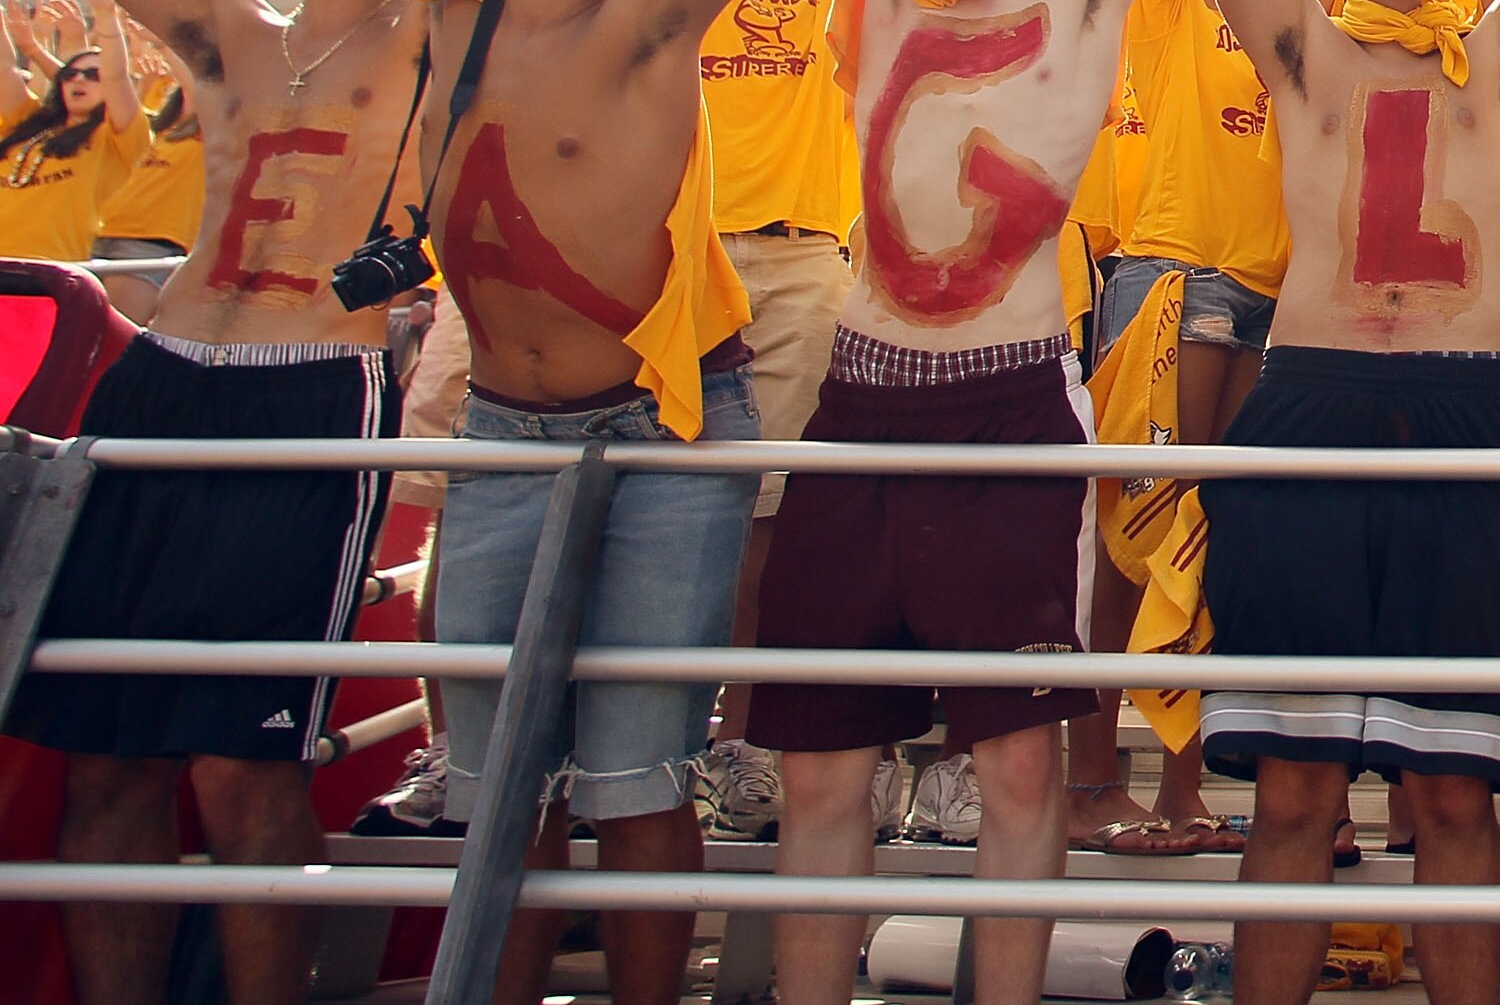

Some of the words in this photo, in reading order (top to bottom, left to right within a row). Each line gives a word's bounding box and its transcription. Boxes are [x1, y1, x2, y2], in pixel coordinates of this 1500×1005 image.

[208, 127, 348, 294] E
[443, 123, 645, 353] A
[863, 13, 1070, 317] G
[1353, 89, 1467, 288] L
